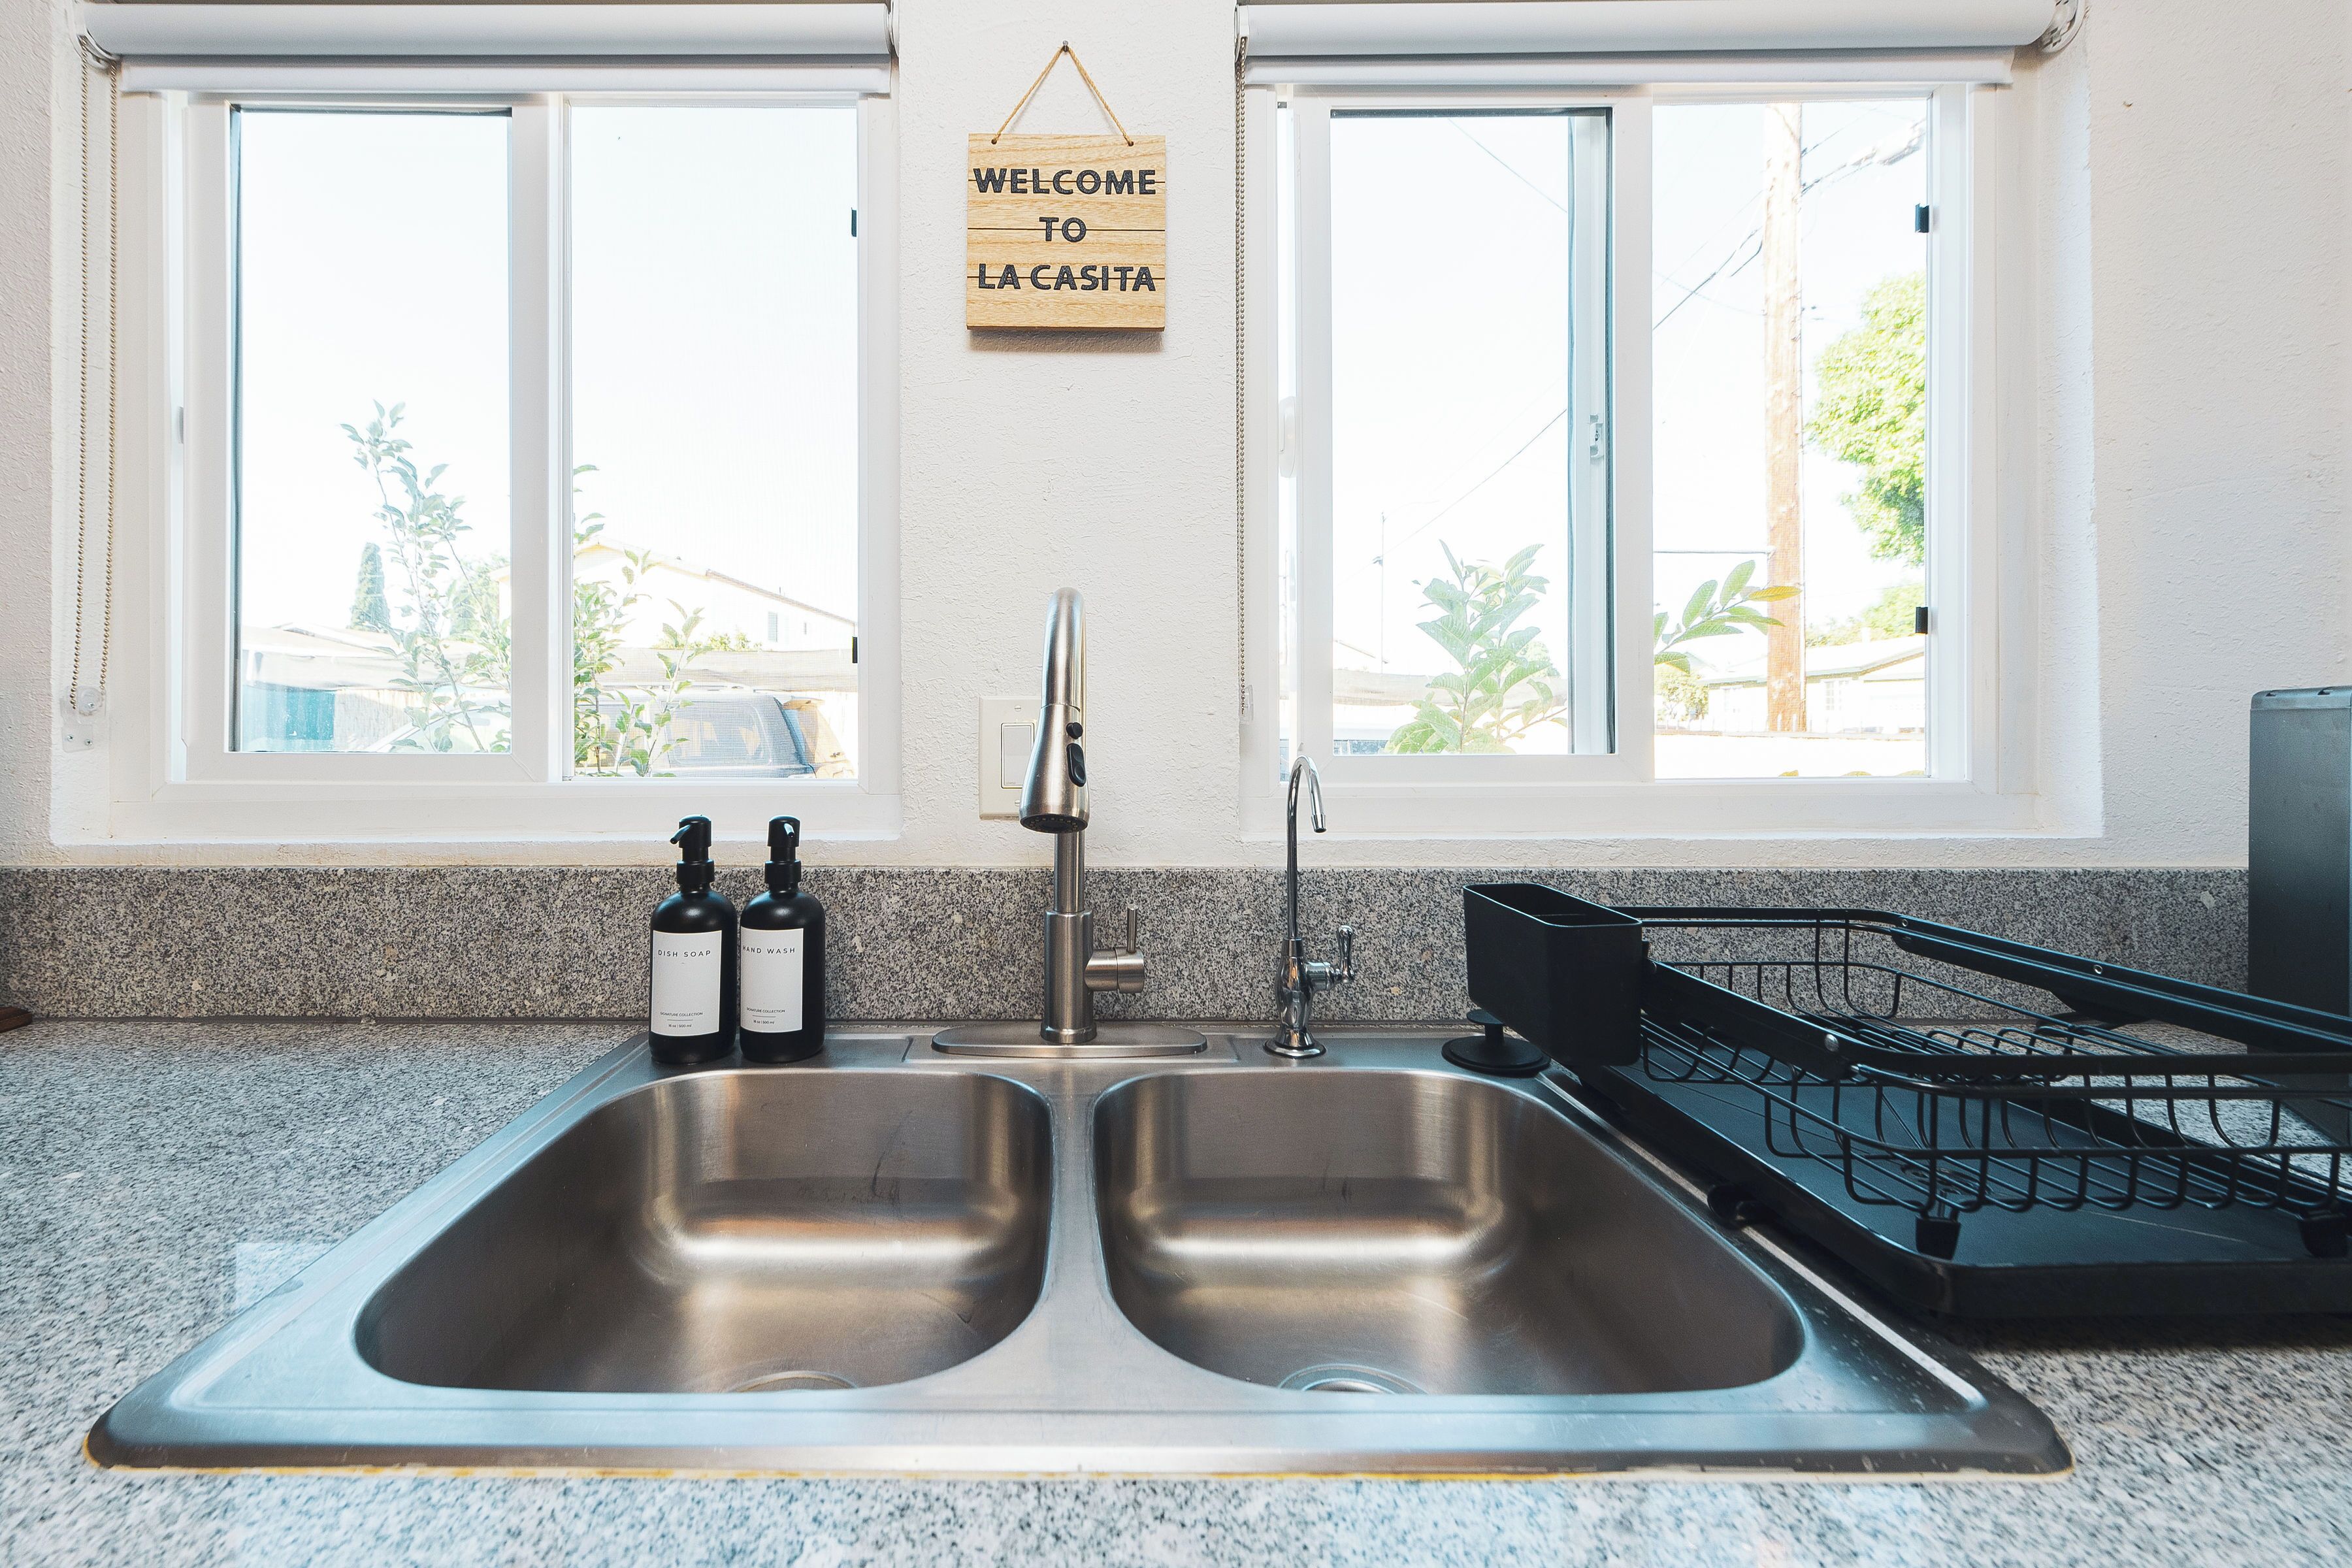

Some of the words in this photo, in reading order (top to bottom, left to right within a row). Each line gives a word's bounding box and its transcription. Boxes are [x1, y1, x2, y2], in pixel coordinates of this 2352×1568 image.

[973, 168, 1156, 195] WELCOME
[1039, 217, 1086, 242] TO
[979, 263, 1021, 289] LA
[1030, 265, 1156, 291] CASITA
[742, 945, 762, 953] HAND
